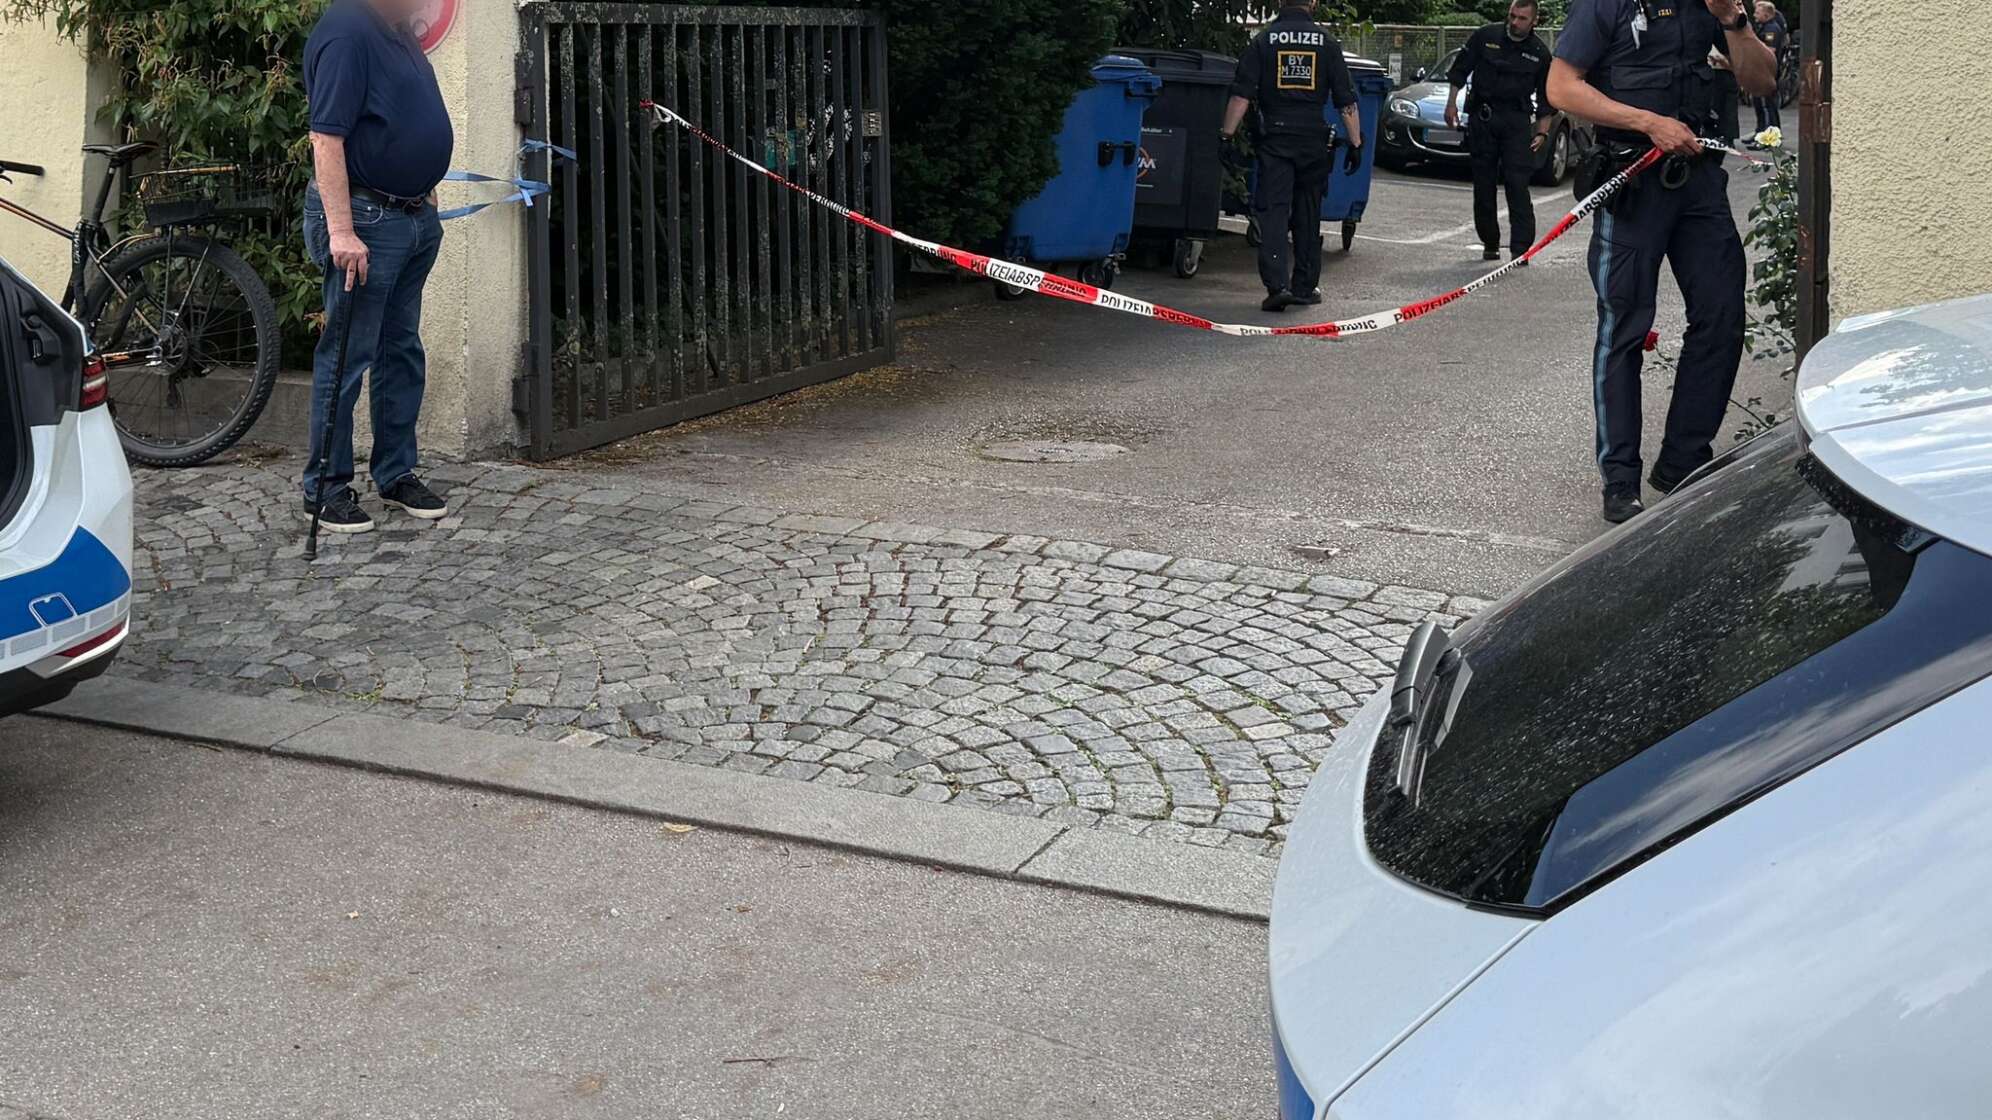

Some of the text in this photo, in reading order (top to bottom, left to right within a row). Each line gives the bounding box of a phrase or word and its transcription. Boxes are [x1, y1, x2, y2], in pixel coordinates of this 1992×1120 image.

[1269, 31, 1324, 46] POLIZEI
[1288, 55, 1304, 65] BY
[1281, 66, 1312, 76] M 7330
